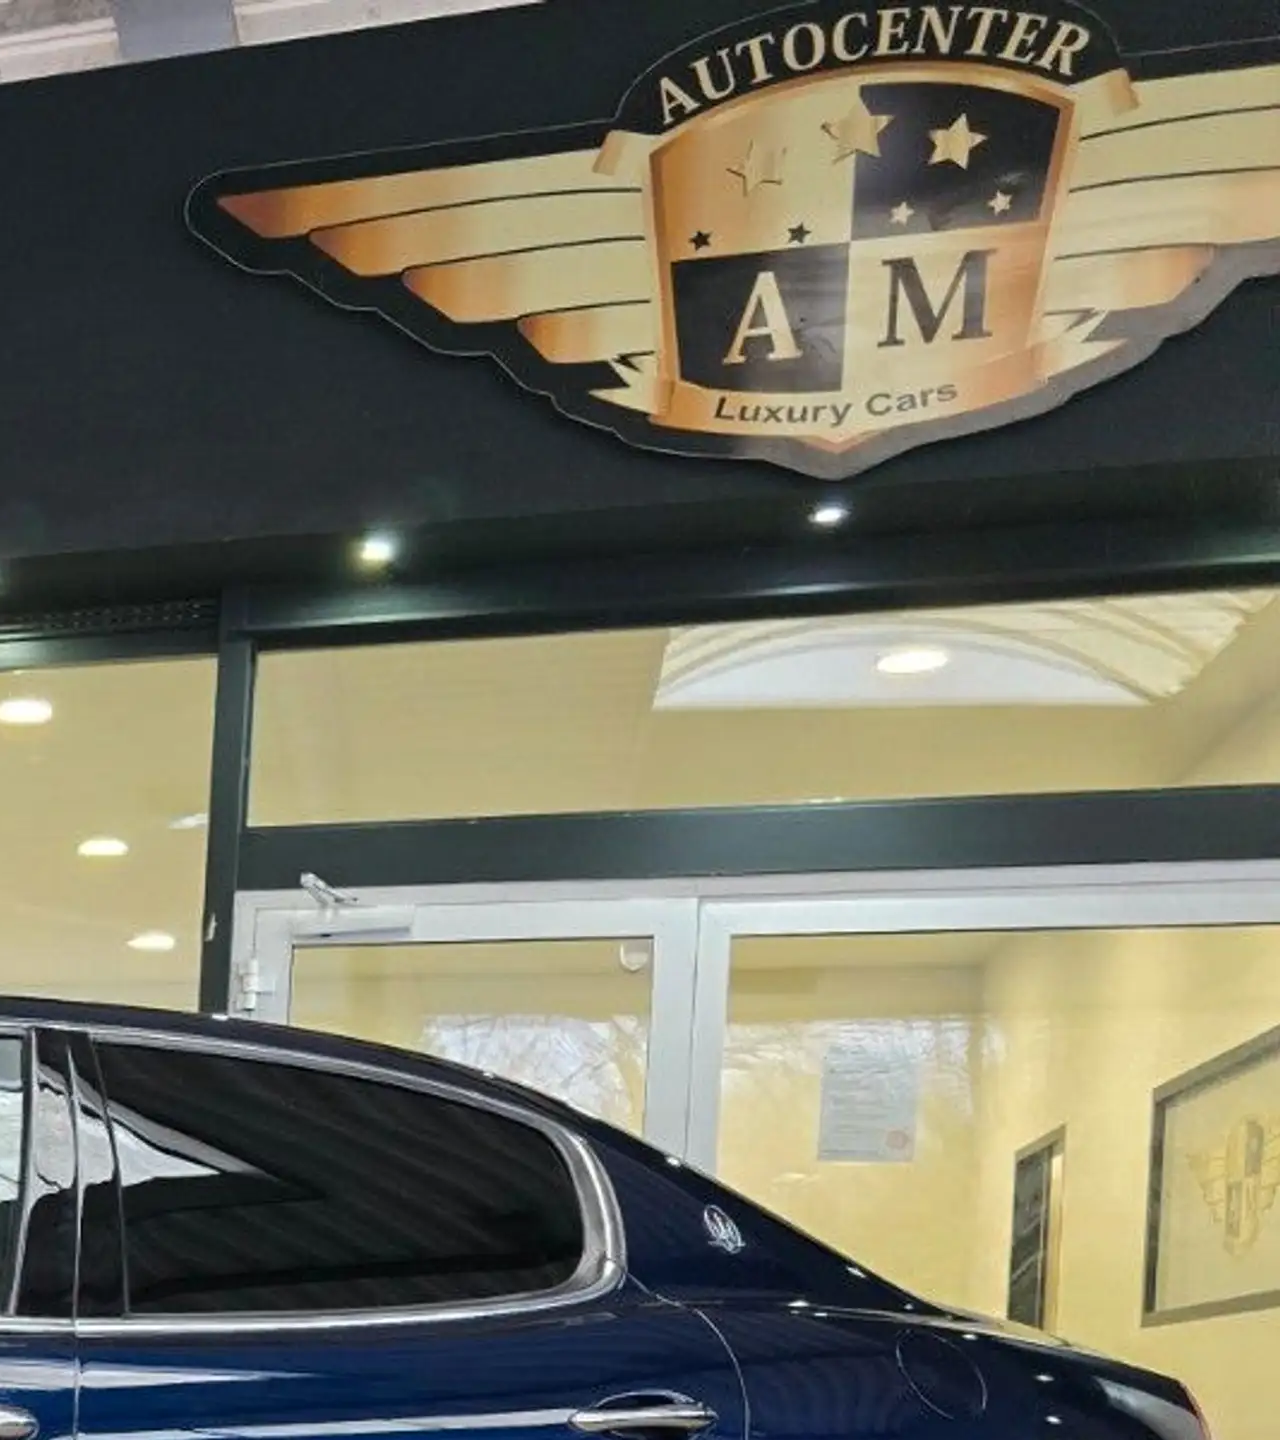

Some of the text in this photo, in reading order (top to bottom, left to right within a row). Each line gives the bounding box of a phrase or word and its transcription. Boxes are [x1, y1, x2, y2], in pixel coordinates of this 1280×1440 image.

[658, 6, 1090, 125] AUTOCENTER
[721, 249, 998, 365] A M
[713, 382, 958, 429] Luxury Cars
